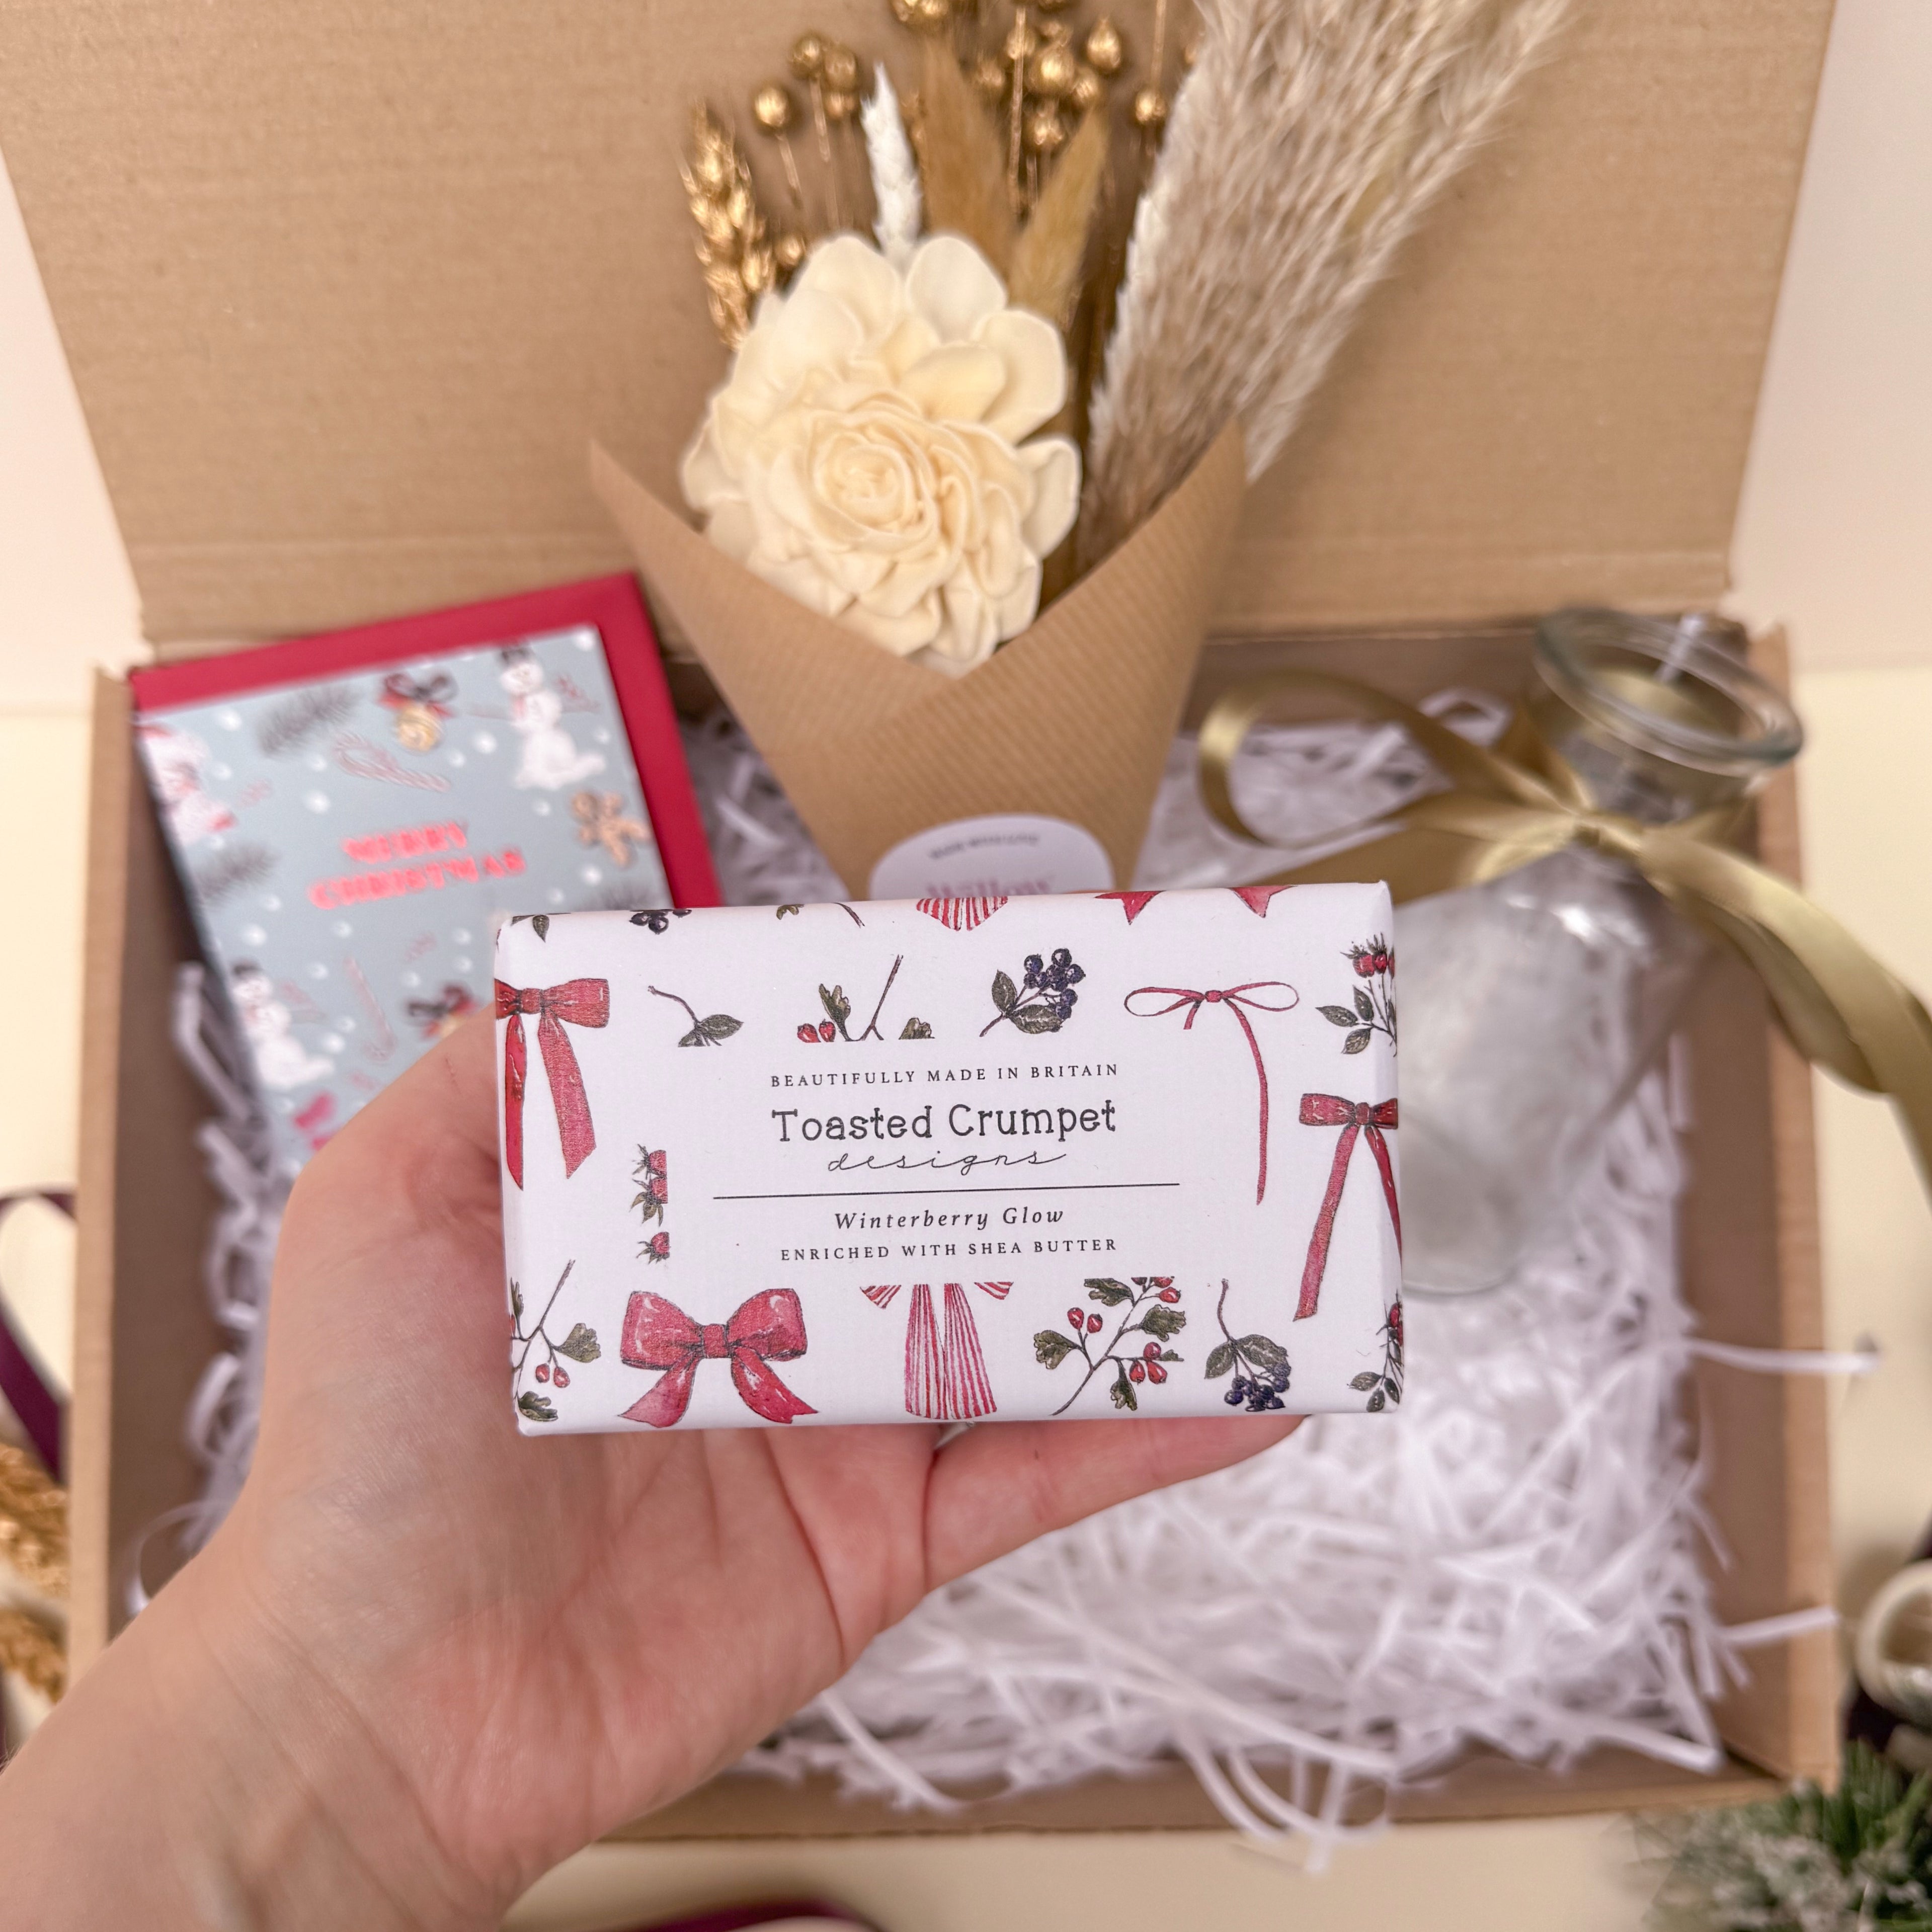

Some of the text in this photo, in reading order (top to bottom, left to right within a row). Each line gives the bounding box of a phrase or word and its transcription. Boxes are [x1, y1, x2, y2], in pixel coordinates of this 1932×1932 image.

[770, 1063, 1118, 1088] BEAUTIFULLY MADE IN BRITAIN
[771, 1099, 1116, 1143] Toasted Crumpet
[827, 1150, 1068, 1177] designs
[834, 1205, 1065, 1231] Winterberry Glow
[780, 1238, 1117, 1261] ENRICHED WITH SHEA BUTTER
